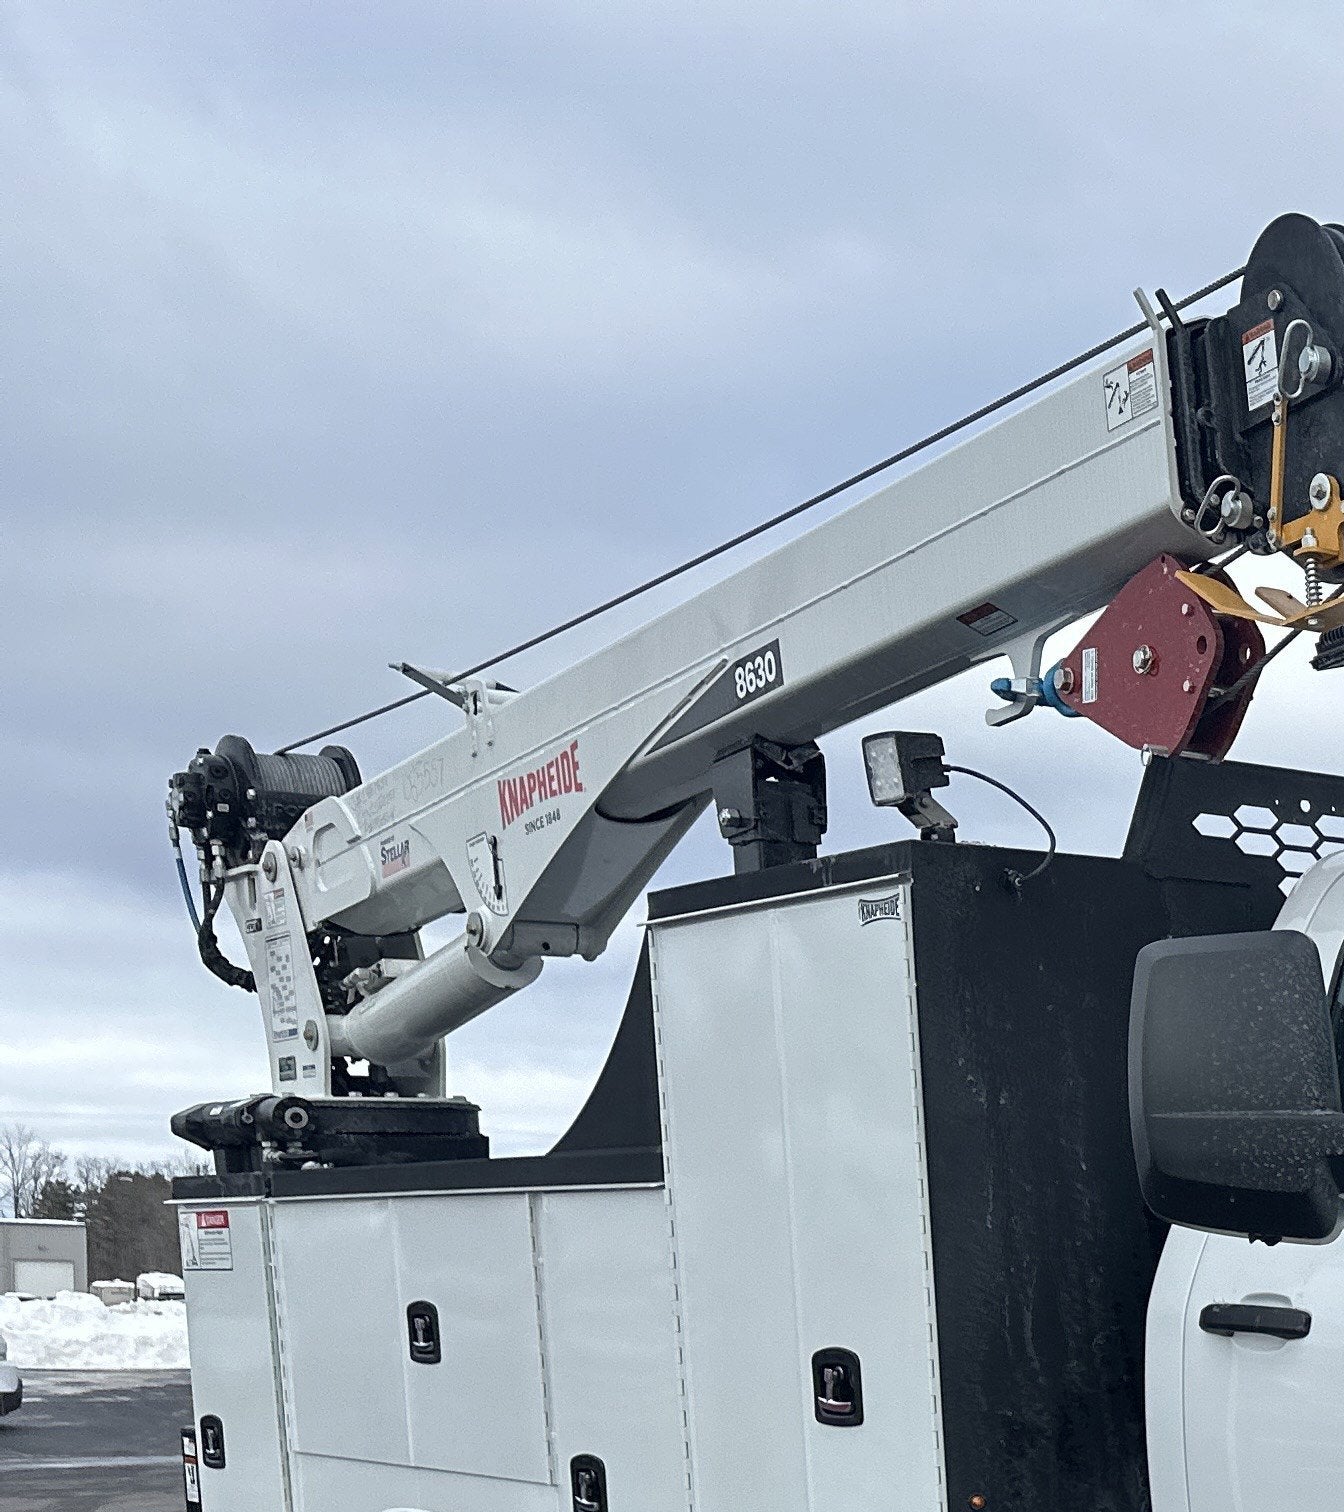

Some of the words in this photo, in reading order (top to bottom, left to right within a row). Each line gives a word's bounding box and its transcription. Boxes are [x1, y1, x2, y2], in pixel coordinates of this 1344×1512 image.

[735, 650, 776, 699] 8630
[497, 739, 584, 830] KNAPHEIDE
[524, 816, 545, 836] SINCE
